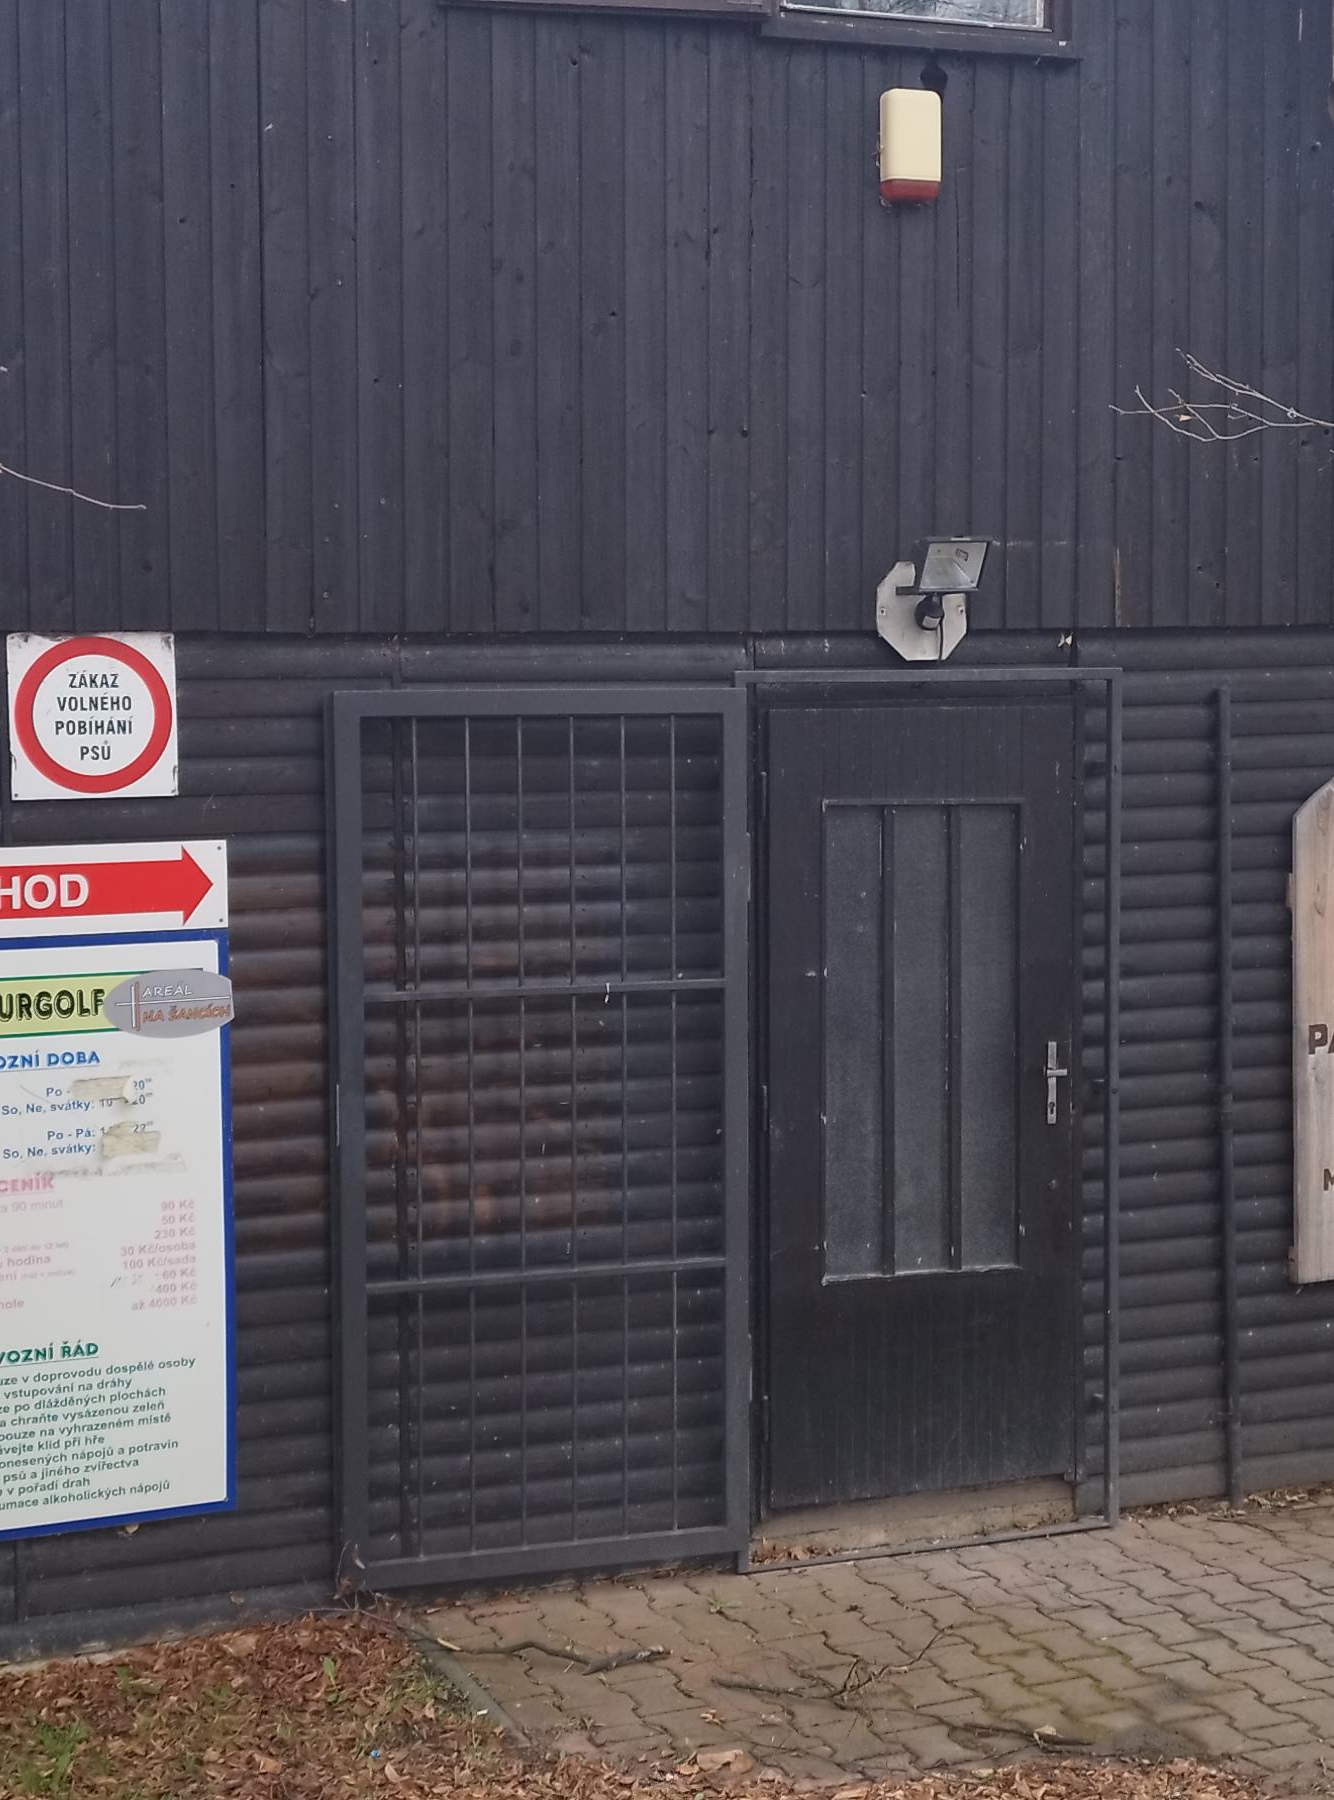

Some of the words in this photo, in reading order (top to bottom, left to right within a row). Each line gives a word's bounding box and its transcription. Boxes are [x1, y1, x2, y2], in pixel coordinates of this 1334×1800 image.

[68, 670, 119, 688] ZÁKAZ
[57, 692, 132, 711] VOLNÉHO
[55, 716, 134, 735] POBÍHÁNÍ
[80, 740, 111, 760] PSŮ
[142, 982, 192, 998] AREÁL
[142, 1009, 164, 1022] NA
[47, 1050, 101, 1067] DOBA
[46, 1087, 63, 1097] Po
[1, 1105, 22, 1116] So,
[26, 1103, 47, 1115] Ne,
[50, 1099, 96, 1112] svátky:
[47, 1131, 64, 1141] Po
[75, 1126, 96, 1138] Pá:
[3, 1148, 23, 1160] So,
[27, 1147, 48, 1158] Ne,
[51, 1143, 96, 1156] svátky:
[178, 1199, 195, 1210] Kč
[179, 1212, 195, 1223] Kč
[179, 1226, 196, 1237] Kč
[7, 1254, 51, 1268] hodina
[180, 1267, 196, 1278] Kč
[181, 1280, 196, 1291] Kč
[181, 1294, 197, 1305] Kč
[61, 1340, 99, 1358] ŘÁD
[22, 1376, 29, 1384] v
[33, 1367, 102, 1386] doprovodu
[105, 1360, 155, 1377] dospělé
[158, 1357, 196, 1370] osoby
[4, 1382, 73, 1400] vstupování
[78, 1383, 93, 1392] na
[97, 1377, 133, 1391] dráhy
[14, 1402, 30, 1413] po
[34, 1393, 106, 1411] dlážděných
[109, 1386, 166, 1403] plochách
[0, 1419, 7, 1428] a
[10, 1412, 58, 1427] chraňte
[62, 1406, 129, 1422] vysázenou
[133, 1400, 165, 1413] zeleň
[40, 1428, 55, 1437] na
[58, 1418, 134, 1437] vyhrazeném
[138, 1414, 172, 1426] místě
[38, 1439, 61, 1451] klid
[64, 1437, 80, 1450] při
[84, 1435, 105, 1446] hře
[71, 1445, 114, 1461] nápojů
[117, 1446, 125, 1455] a
[128, 1440, 179, 1455] potravin
[3, 1471, 27, 1484] psů
[30, 1471, 37, 1479] a
[41, 1465, 80, 1480] jiného
[83, 1458, 139, 1473] zvířectva
[7, 1487, 14, 1495] v
[18, 1480, 58, 1496] pořadí
[62, 1477, 91, 1489] drah
[42, 1487, 126, 1506] alkoholických
[130, 1480, 170, 1495] nápojů
